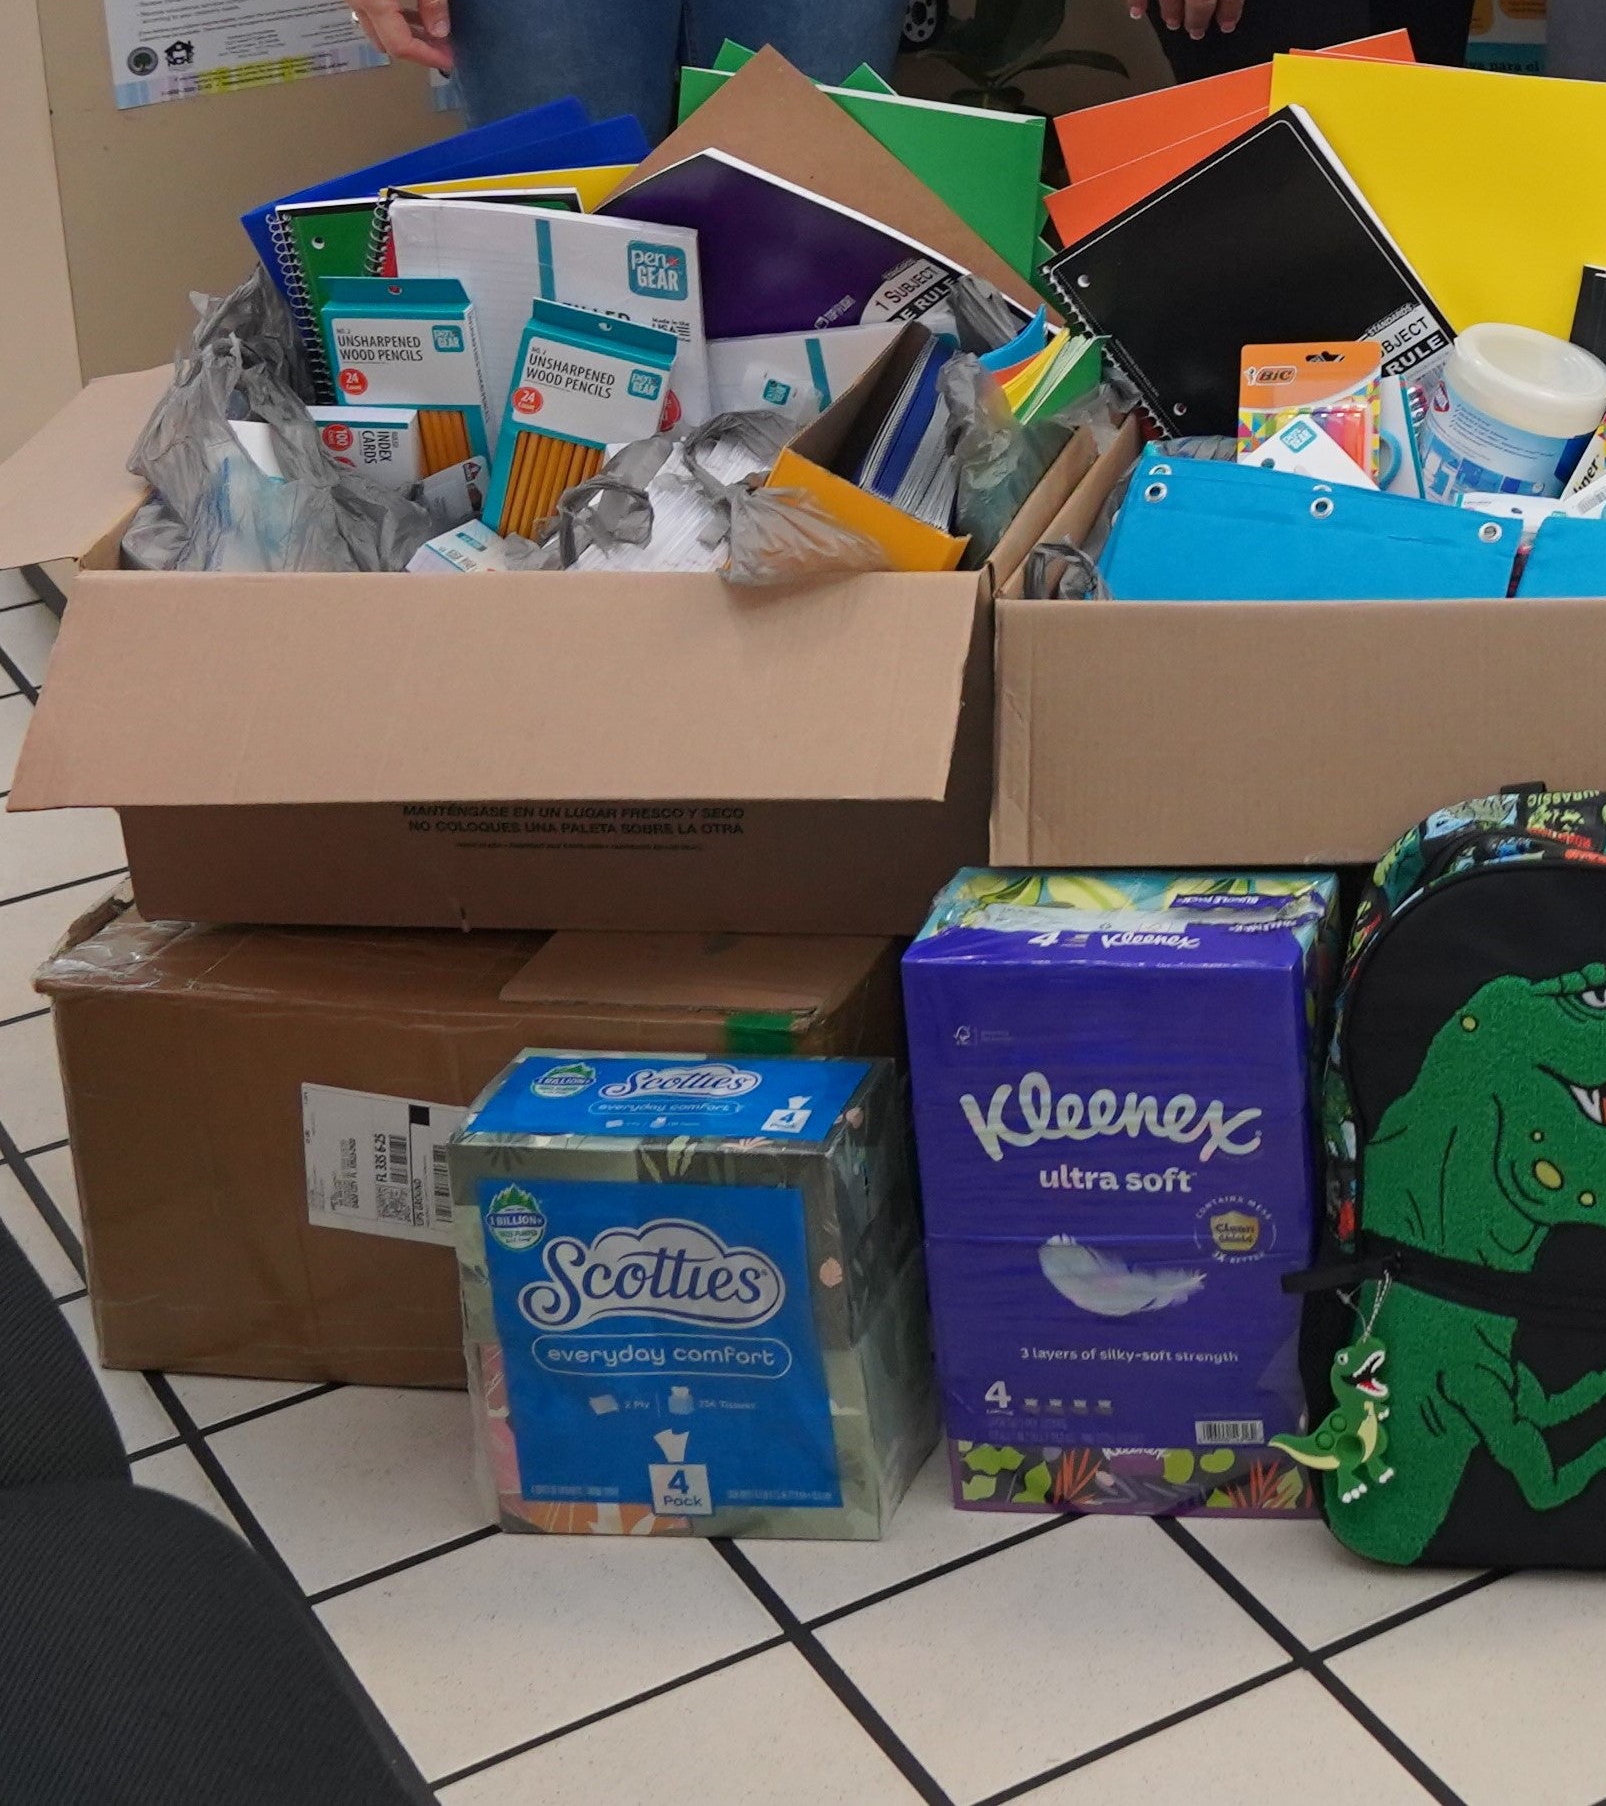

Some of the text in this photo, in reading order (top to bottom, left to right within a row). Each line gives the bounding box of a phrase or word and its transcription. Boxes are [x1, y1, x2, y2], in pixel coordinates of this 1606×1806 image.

[637, 267, 679, 291] GEAR
[875, 300, 889, 311] 1
[884, 266, 939, 304] SUBJECT
[338, 335, 421, 348] UNSHARPENED
[339, 349, 423, 362] WOOD PENCILS
[1385, 335, 1445, 375] RULE
[345, 372, 359, 385] 24
[528, 353, 615, 386] UNSHARPENED
[526, 367, 612, 400] WOOD PENCILS
[521, 390, 536, 404] 24
[362, 431, 378, 464] CARDS
[377, 431, 392, 463] INDEX
[513, 807, 537, 817] EN
[539, 807, 562, 817] UN
[564, 807, 615, 818] LUGAR
[620, 807, 683, 819] FRESCO
[702, 808, 744, 819] SECO
[409, 821, 430, 832] NO
[436, 821, 520, 833] COLOQUES
[561, 822, 615, 834] PALETA
[620, 823, 674, 835] SOBRE
[702, 823, 744, 835] OTRA
[1028, 932, 1200, 949] 4 Kleenex
[601, 1069, 751, 1096] Scotties
[778, 1110, 797, 1124] 4
[960, 1071, 1263, 1163] Kleenex
[1039, 1165, 1192, 1193] ultra soft
[522, 1240, 764, 1325] Scotties
[547, 1344, 775, 1366] everyday comfort
[1020, 1348, 1238, 1364] 3 layers of silky-soft strength
[984, 1381, 1012, 1408] 4
[667, 1469, 689, 1494] 4
[663, 1495, 703, 1507] Pack
